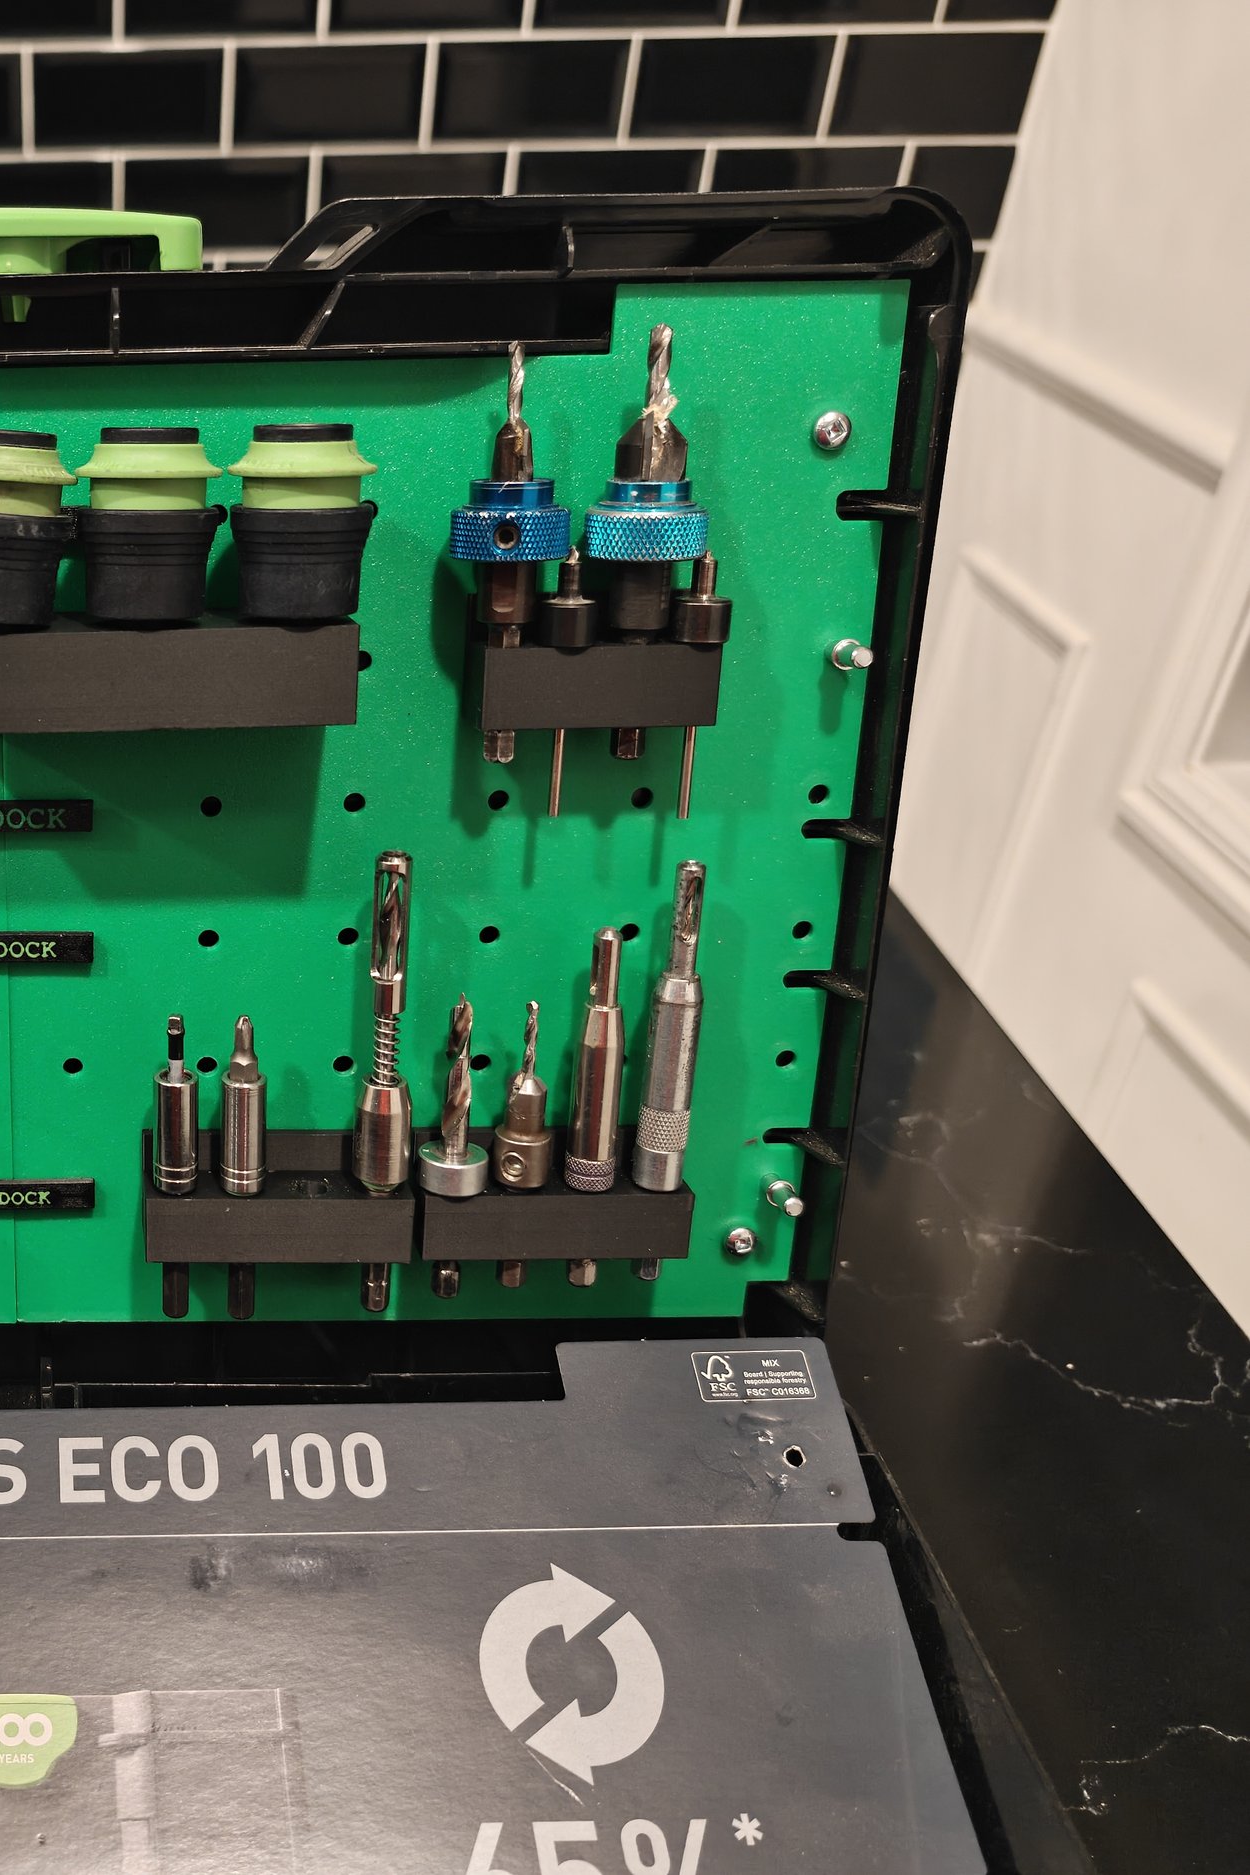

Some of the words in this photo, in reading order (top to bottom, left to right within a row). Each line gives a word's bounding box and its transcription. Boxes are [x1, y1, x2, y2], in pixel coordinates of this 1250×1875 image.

[761, 1359, 780, 1367] MIX
[768, 1370, 804, 1378] Supporting
[743, 1378, 781, 1386] responsible
[781, 1377, 807, 1385] forestry
[709, 1382, 737, 1392] FSC
[771, 1387, 810, 1396] C016368
[58, 1434, 219, 1503] ECO
[251, 1431, 388, 1500] 100
